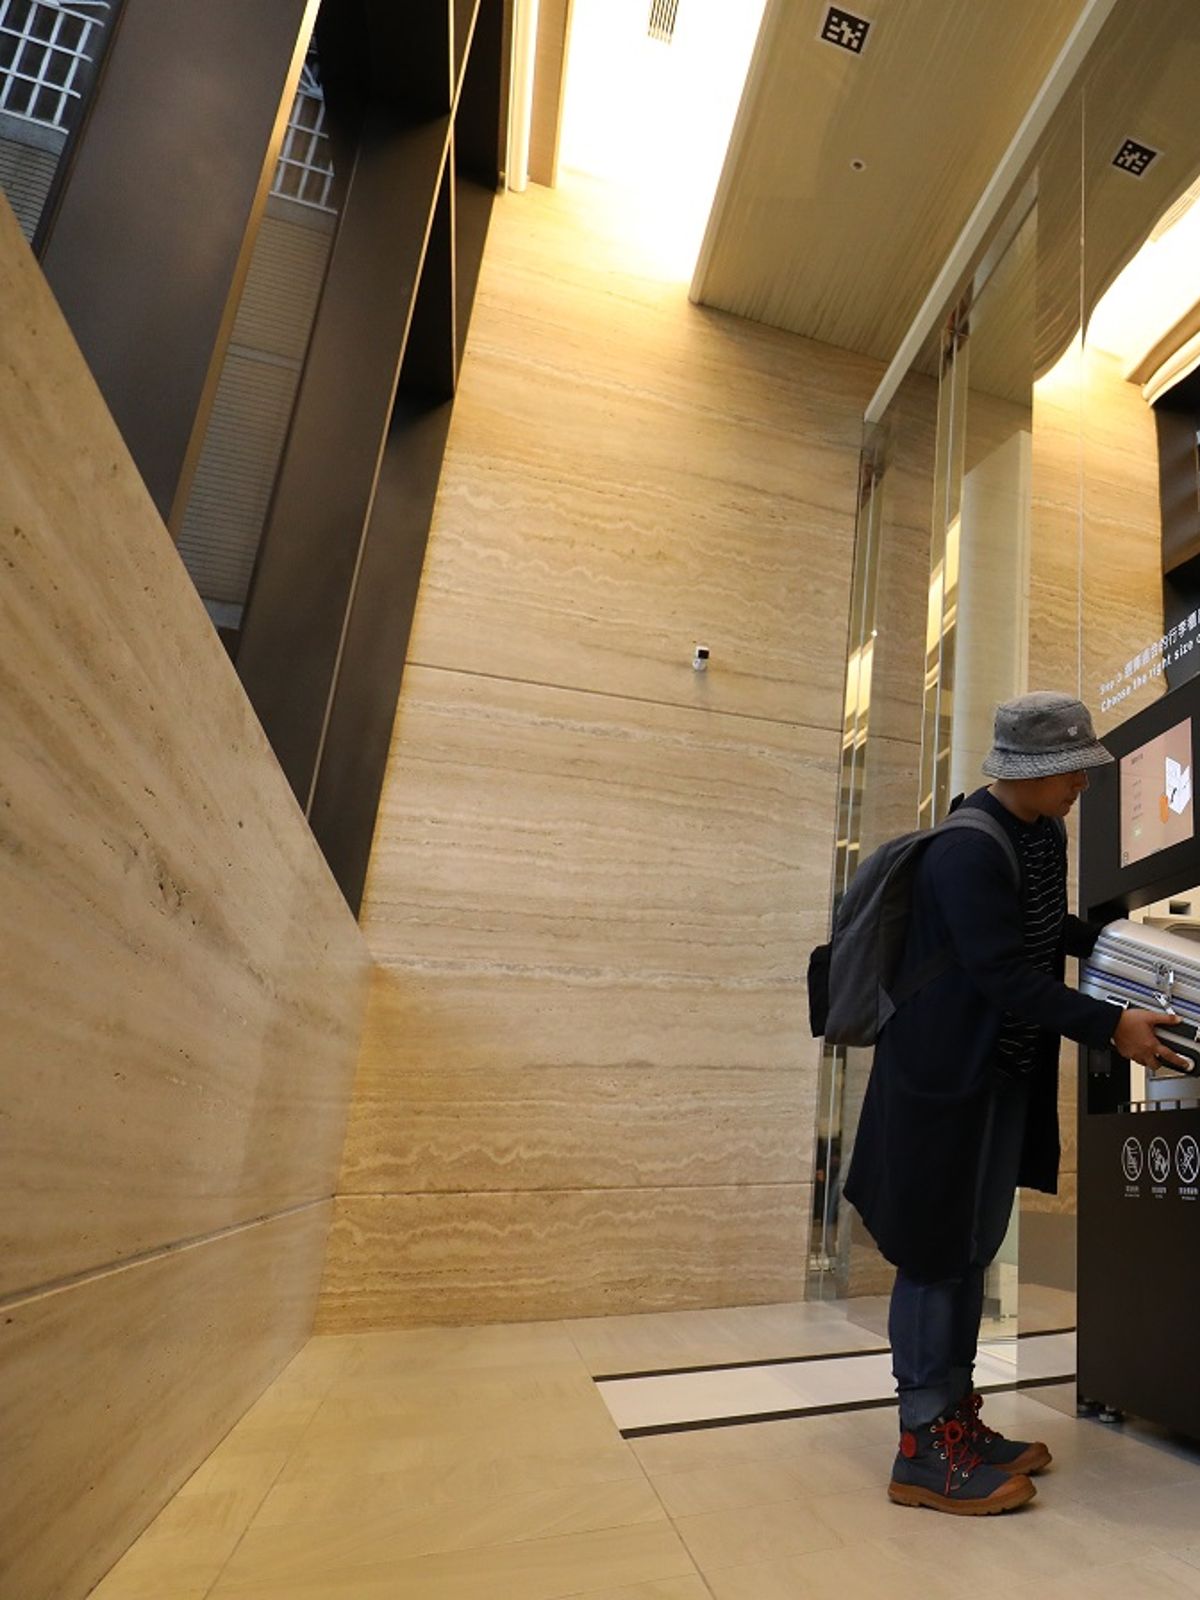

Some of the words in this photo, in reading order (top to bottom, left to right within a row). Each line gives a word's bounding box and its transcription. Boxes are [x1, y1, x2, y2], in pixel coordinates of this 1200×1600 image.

[1101, 686, 1131, 712] Choose
[1149, 653, 1172, 678] right
[1174, 640, 1193, 660] size
